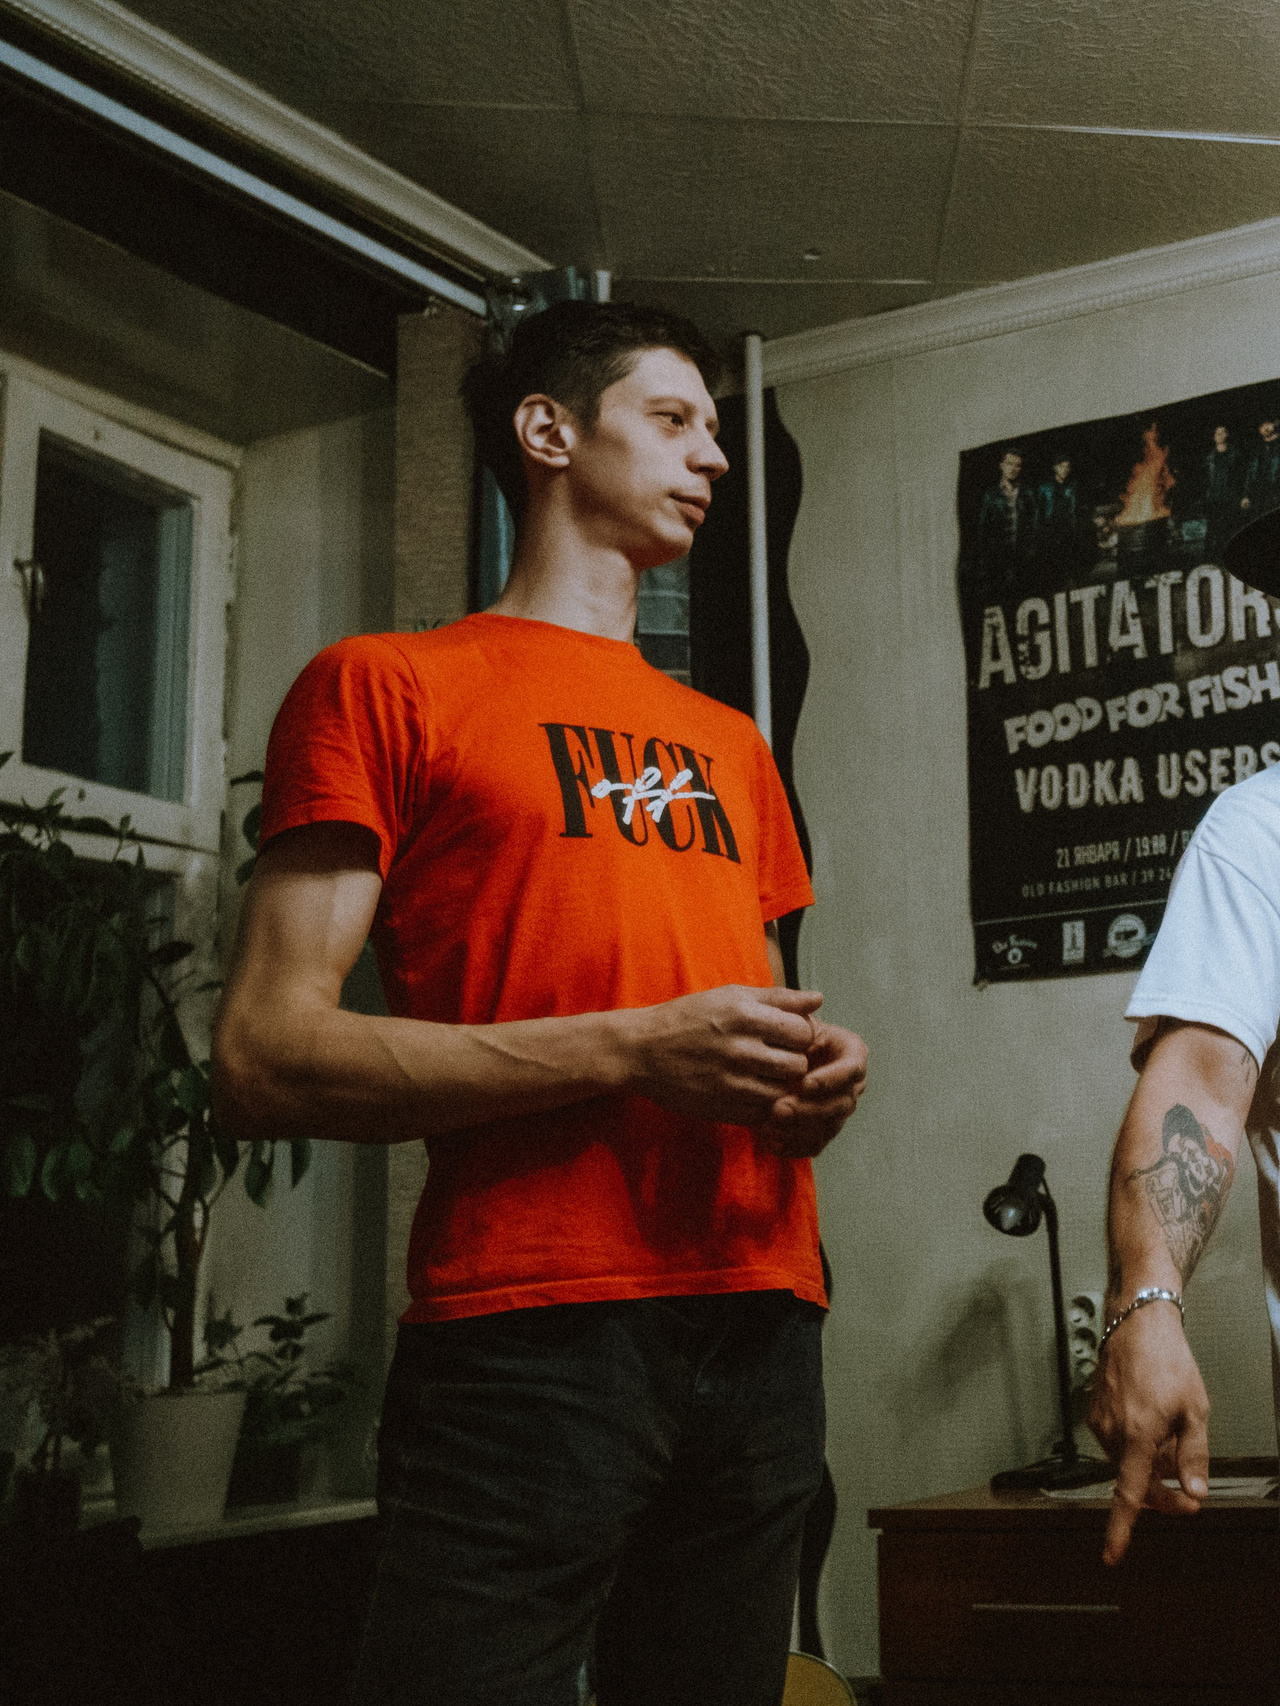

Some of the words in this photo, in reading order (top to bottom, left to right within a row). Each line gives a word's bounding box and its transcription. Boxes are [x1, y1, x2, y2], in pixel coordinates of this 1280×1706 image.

[1003, 697, 1102, 754] FOOD
[1106, 682, 1185, 732] FOR
[537, 722, 742, 865] FUCK
[1013, 756, 1145, 814] VODKA
[1056, 848, 1070, 869] 21
[1073, 840, 1120, 867] ЯНВАРЯ
[1021, 883, 1044, 898] OLD
[1049, 877, 1100, 895] FASHION
[1104, 872, 1129, 888] BAR
